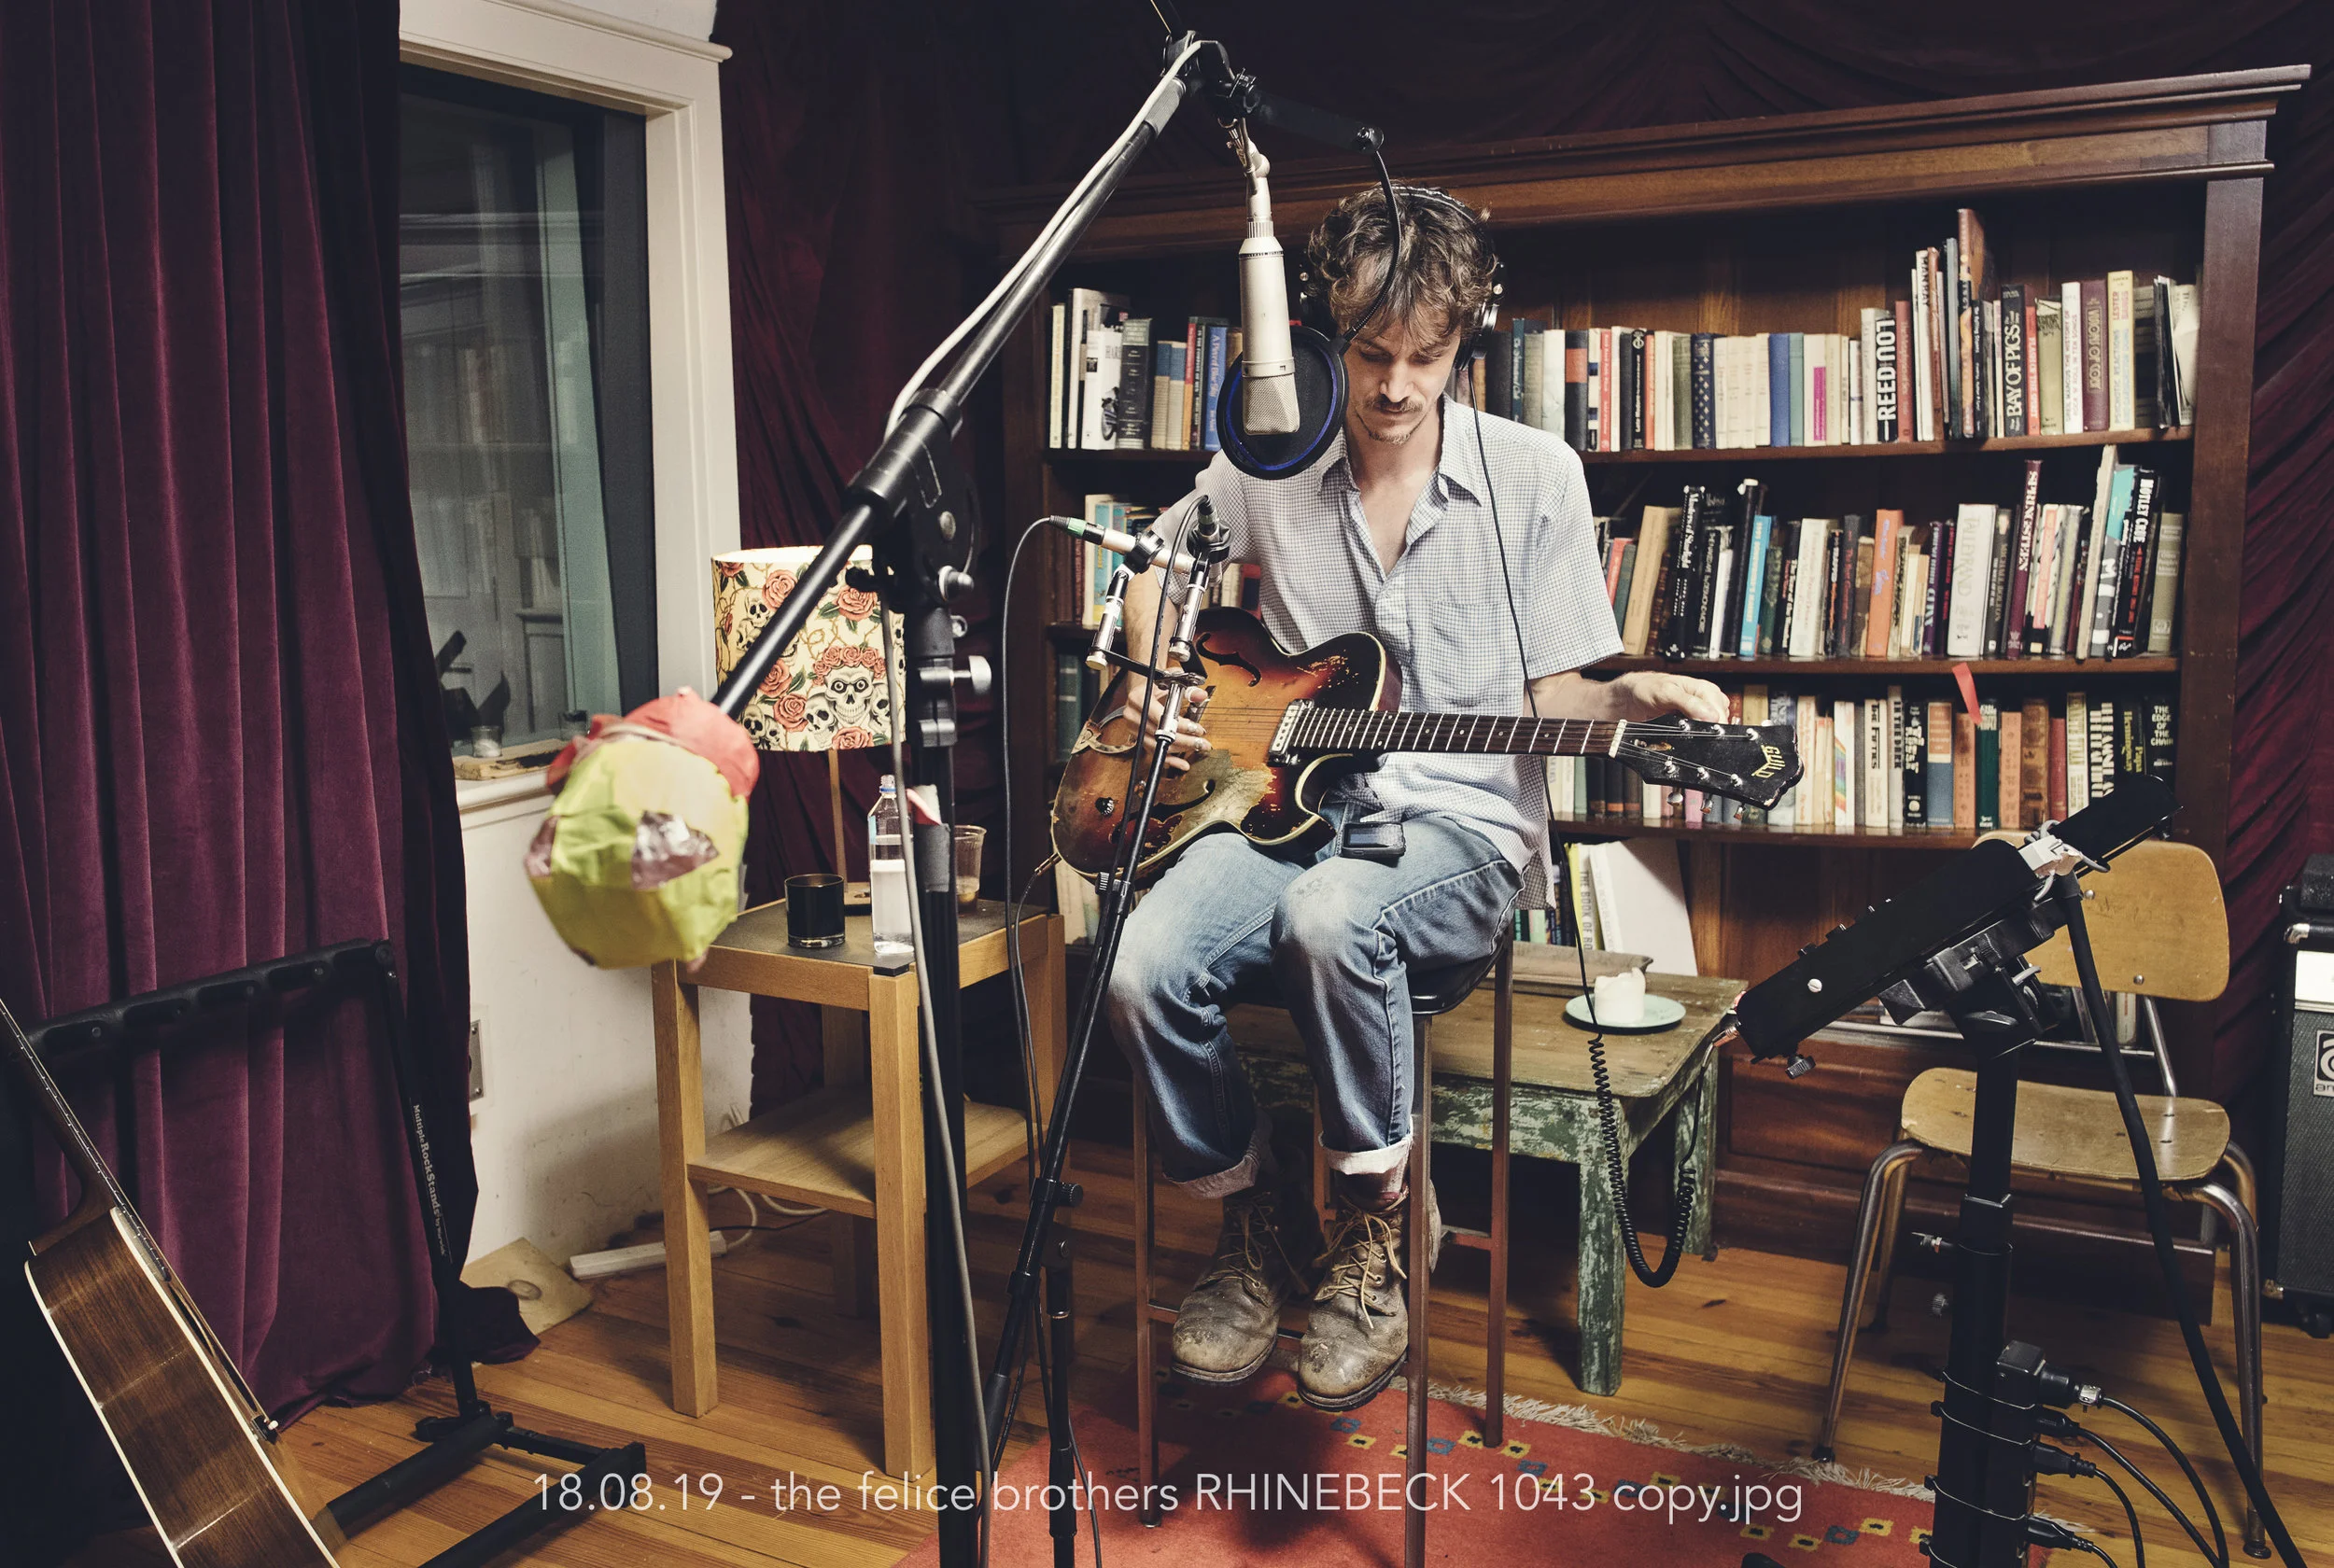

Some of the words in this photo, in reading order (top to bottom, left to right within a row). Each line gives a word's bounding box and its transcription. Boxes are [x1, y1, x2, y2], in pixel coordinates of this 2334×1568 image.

[2004, 324, 2021, 360] PIGS
[2004, 361, 2021, 385] OF
[1877, 367, 1896, 421] REED
[2005, 385, 2022, 416] BAY
[2017, 469, 2038, 571] SPRINGSTEEN
[1871, 702, 1879, 722] THE
[1893, 701, 1901, 712] IN
[2152, 714, 2171, 722] EDGE
[2154, 706, 2169, 714] THE
[1892, 716, 1902, 736] THE
[2154, 730, 2170, 738] THE
[1870, 726, 1880, 769] FIFTIES
[1893, 739, 1902, 768] DARK
[2133, 746, 2144, 773] Papa
[1755, 746, 1786, 778] GUILD
[1581, 869, 1590, 888] THE
[1581, 889, 1593, 917] BOOK
[1582, 920, 1593, 933] OF
